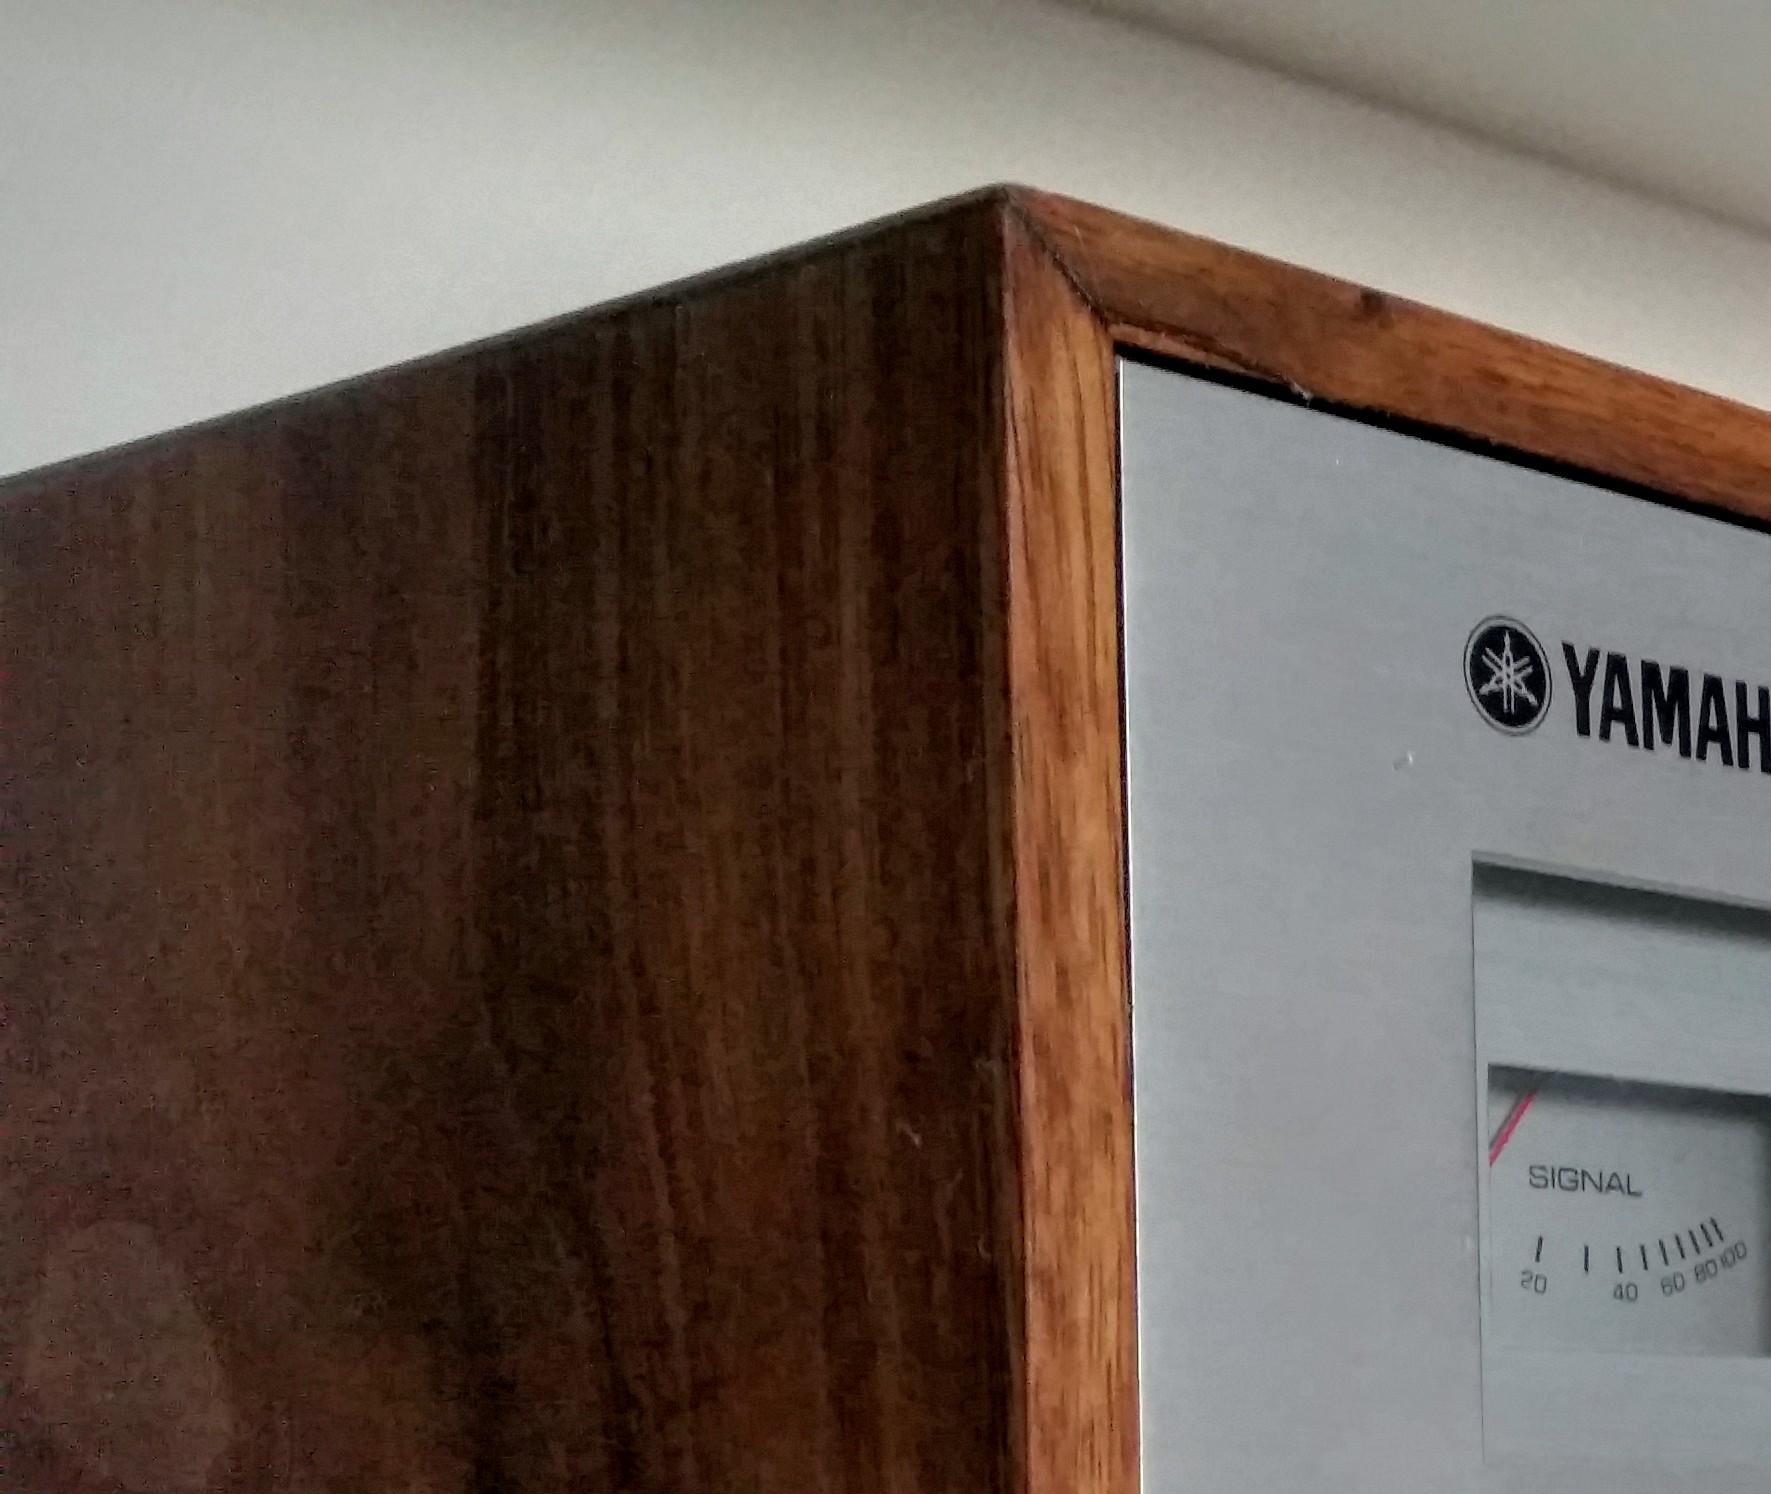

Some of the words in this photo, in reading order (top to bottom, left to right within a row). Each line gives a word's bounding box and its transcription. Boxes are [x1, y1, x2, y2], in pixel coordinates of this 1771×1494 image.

[1529, 1165, 1643, 1198] SIGNAL
[1520, 1270, 1548, 1295] 20
[1612, 1282, 1639, 1303] 40
[1660, 1271, 1686, 1297] 60
[1693, 1257, 1720, 1285] 80
[1718, 1239, 1749, 1270] 100
